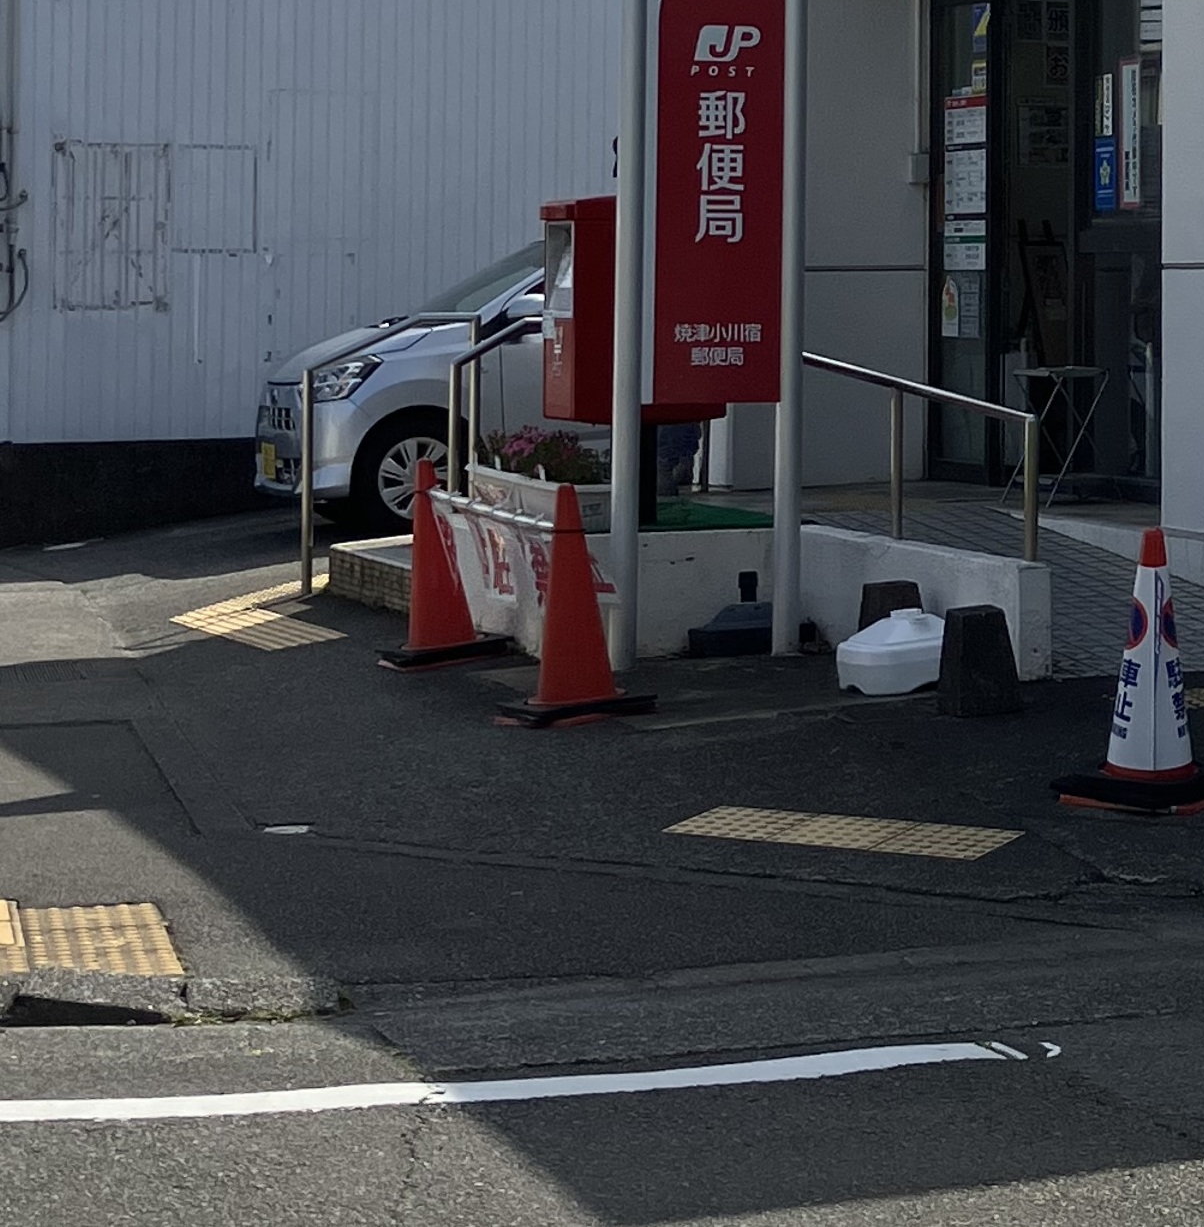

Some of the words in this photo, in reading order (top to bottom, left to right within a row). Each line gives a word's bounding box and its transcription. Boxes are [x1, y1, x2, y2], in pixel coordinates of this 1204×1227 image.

[690, 65, 756, 77] POST
[696, 90, 746, 243] 郵便局
[674, 323, 762, 343] 焼津小川宿
[691, 347, 744, 366] 郵便局
